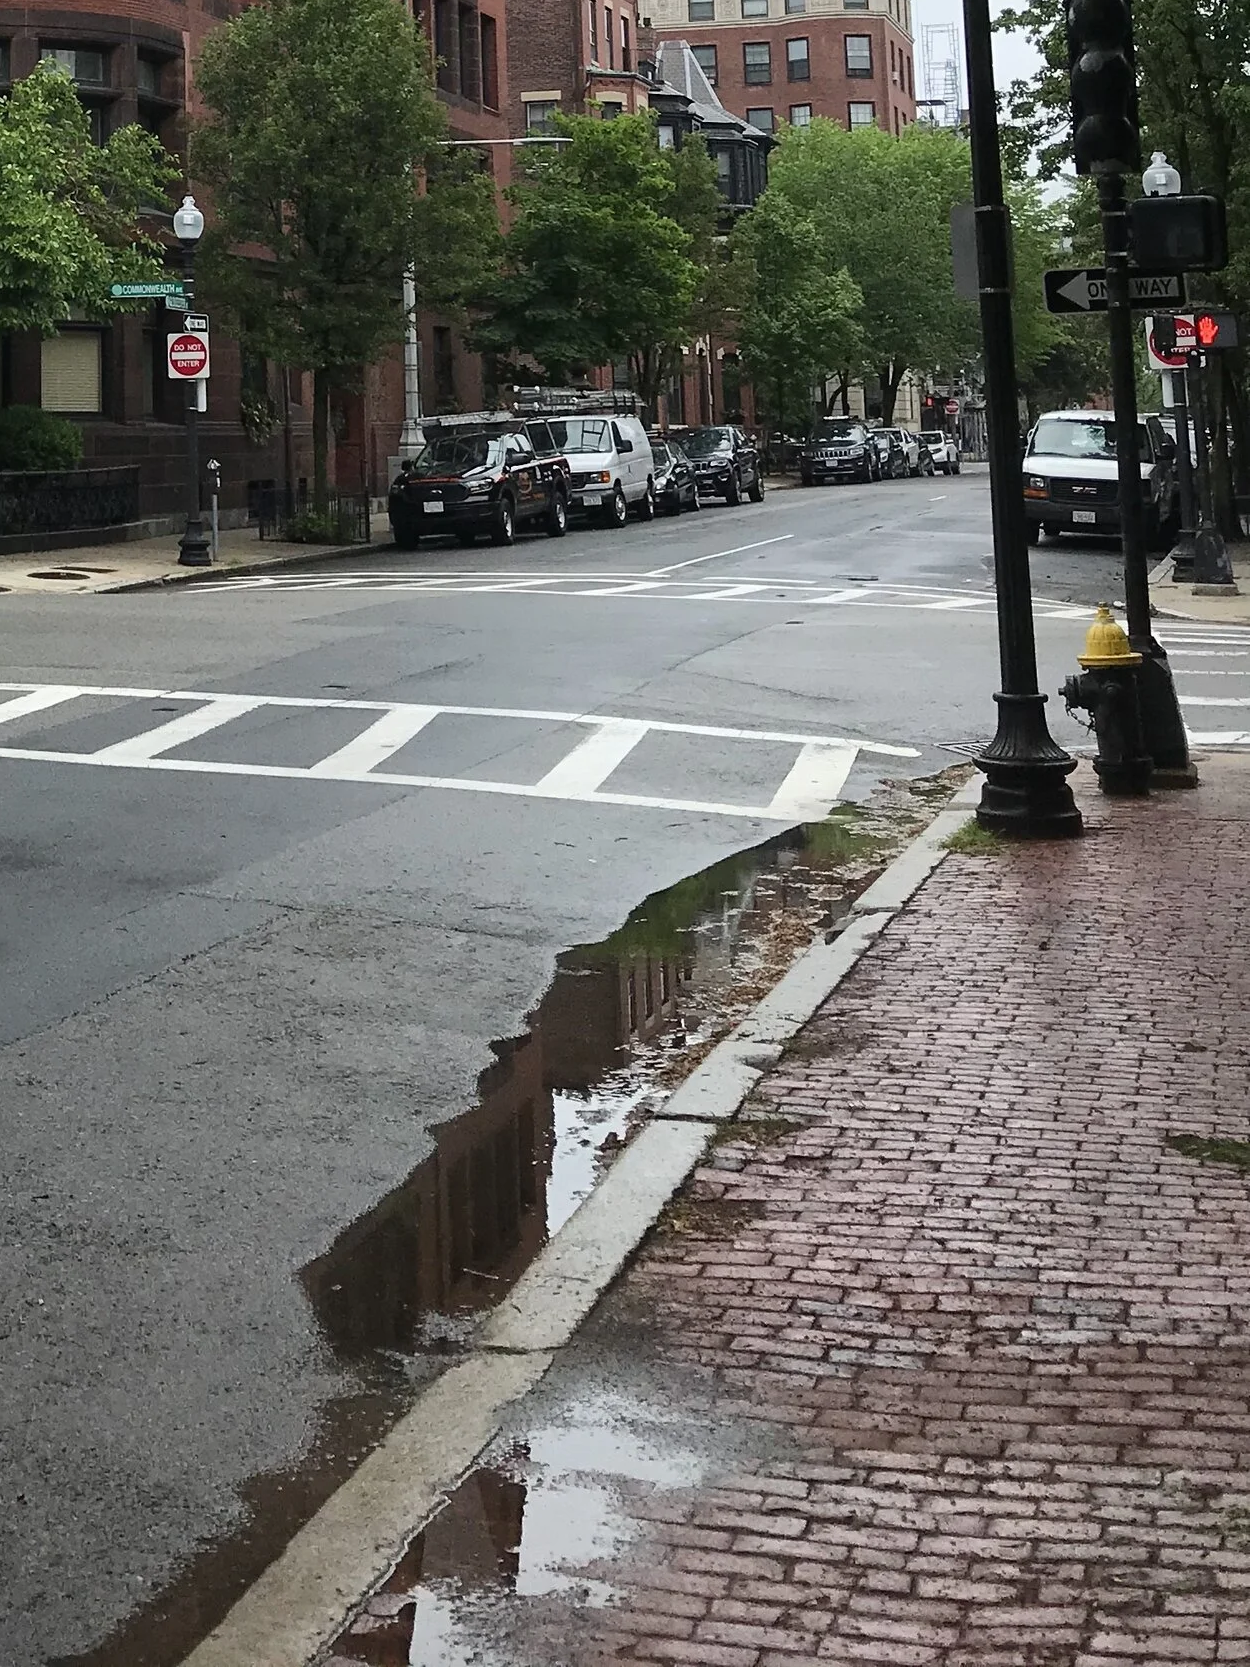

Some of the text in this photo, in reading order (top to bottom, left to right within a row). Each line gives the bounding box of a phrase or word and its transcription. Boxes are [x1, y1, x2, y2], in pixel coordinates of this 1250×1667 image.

[122, 284, 175, 295] COMMONWEALTH
[1087, 279, 1172, 298] ON WAY
[187, 343, 202, 351] NOT
[177, 360, 200, 368] ENTER
